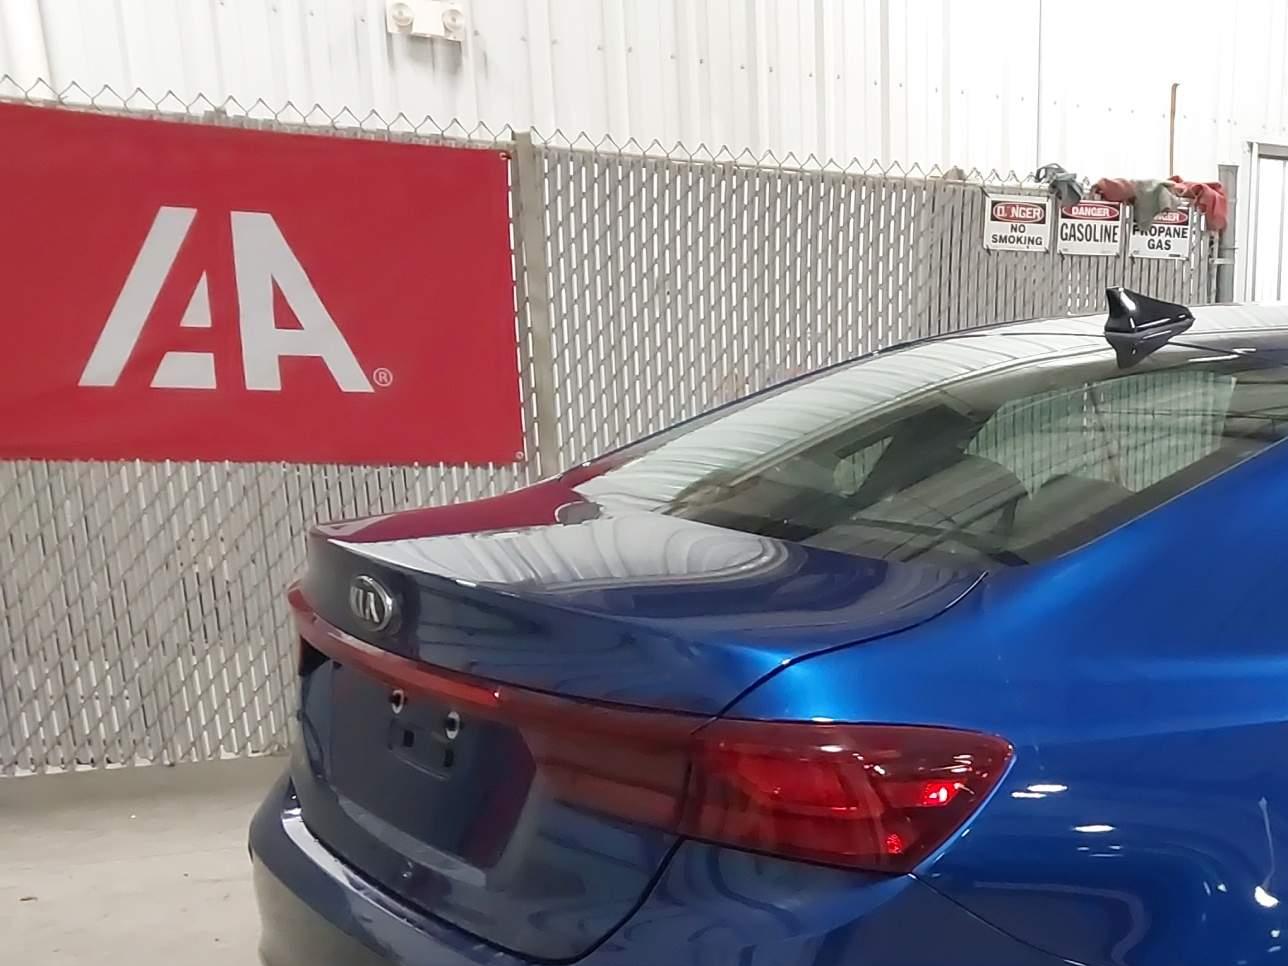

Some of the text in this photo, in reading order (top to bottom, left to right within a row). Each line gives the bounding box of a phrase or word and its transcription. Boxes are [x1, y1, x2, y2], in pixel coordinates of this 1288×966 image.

[1072, 206, 1110, 217] DANGER
[1010, 223, 1026, 233] NO
[1060, 222, 1119, 243] GASOLINE
[991, 233, 1043, 246] SMOKING
[1147, 238, 1172, 251] GAS
